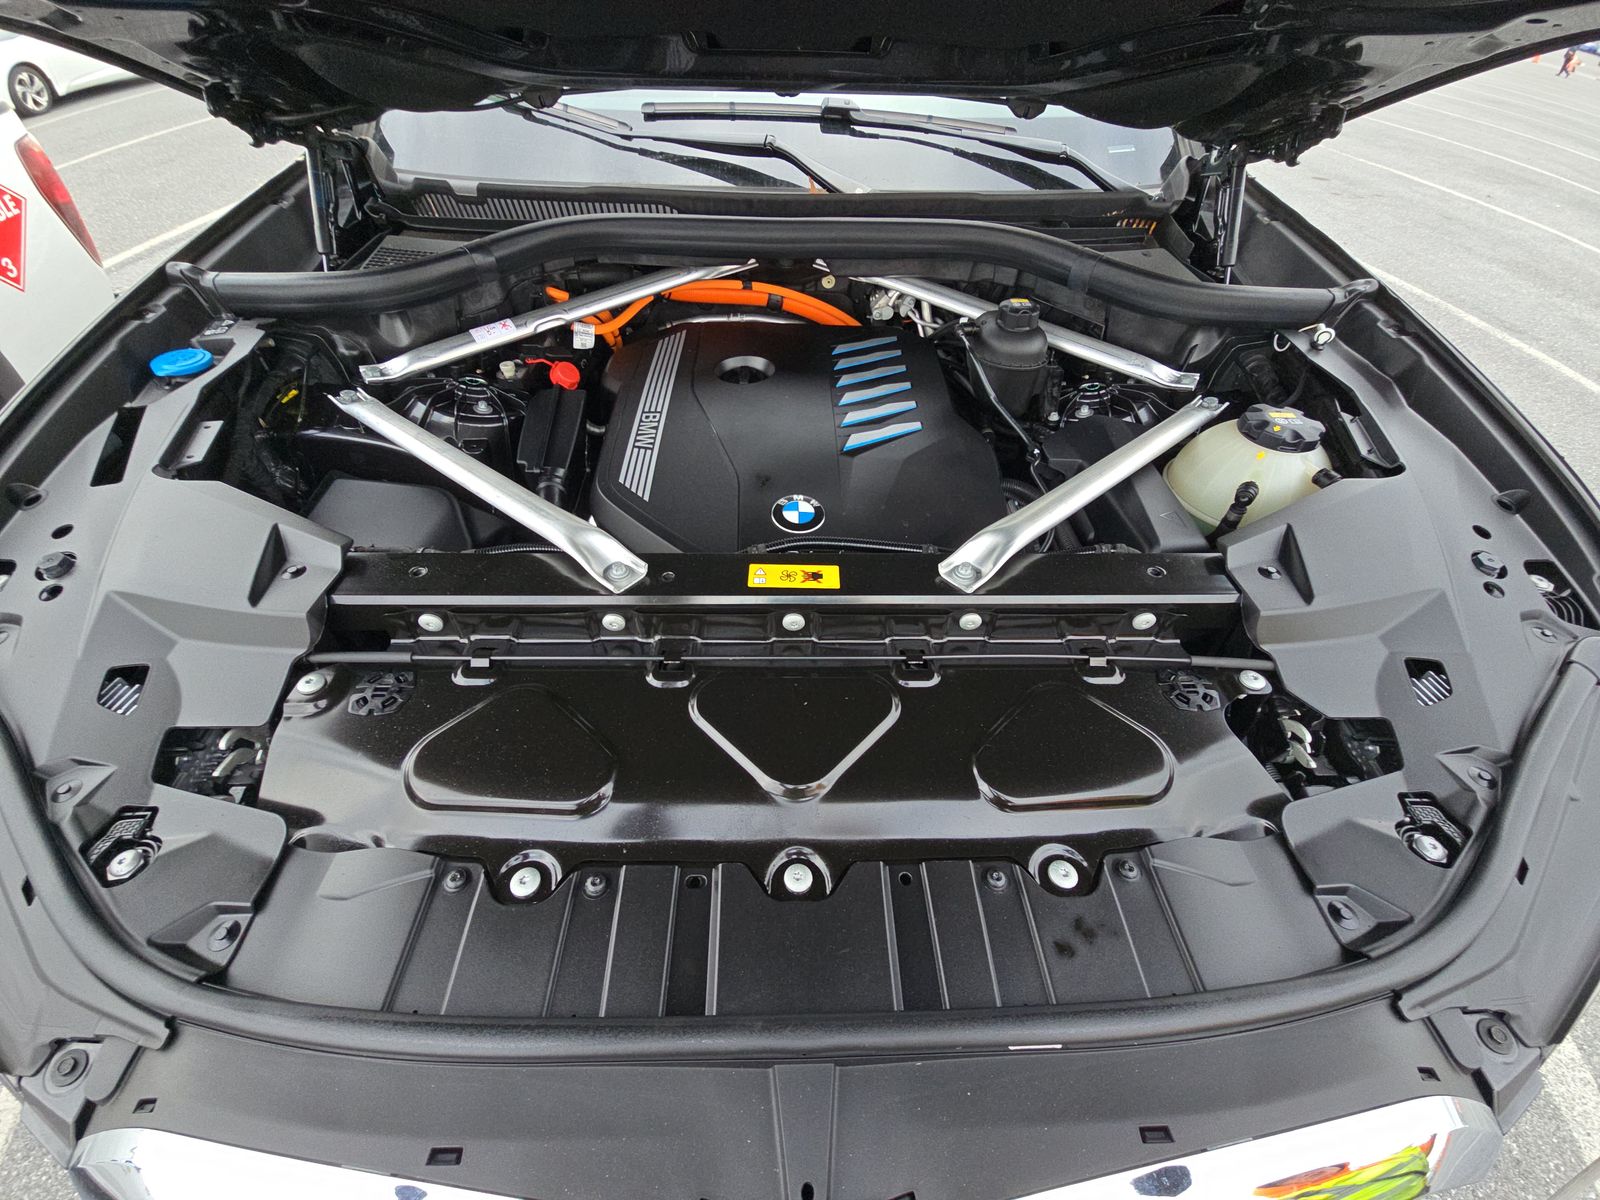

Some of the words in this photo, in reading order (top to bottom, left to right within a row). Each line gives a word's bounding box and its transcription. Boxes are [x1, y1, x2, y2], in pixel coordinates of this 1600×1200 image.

[1, 257, 18, 278] 3
[634, 412, 661, 449] BMW
[777, 494, 821, 507] BMW
